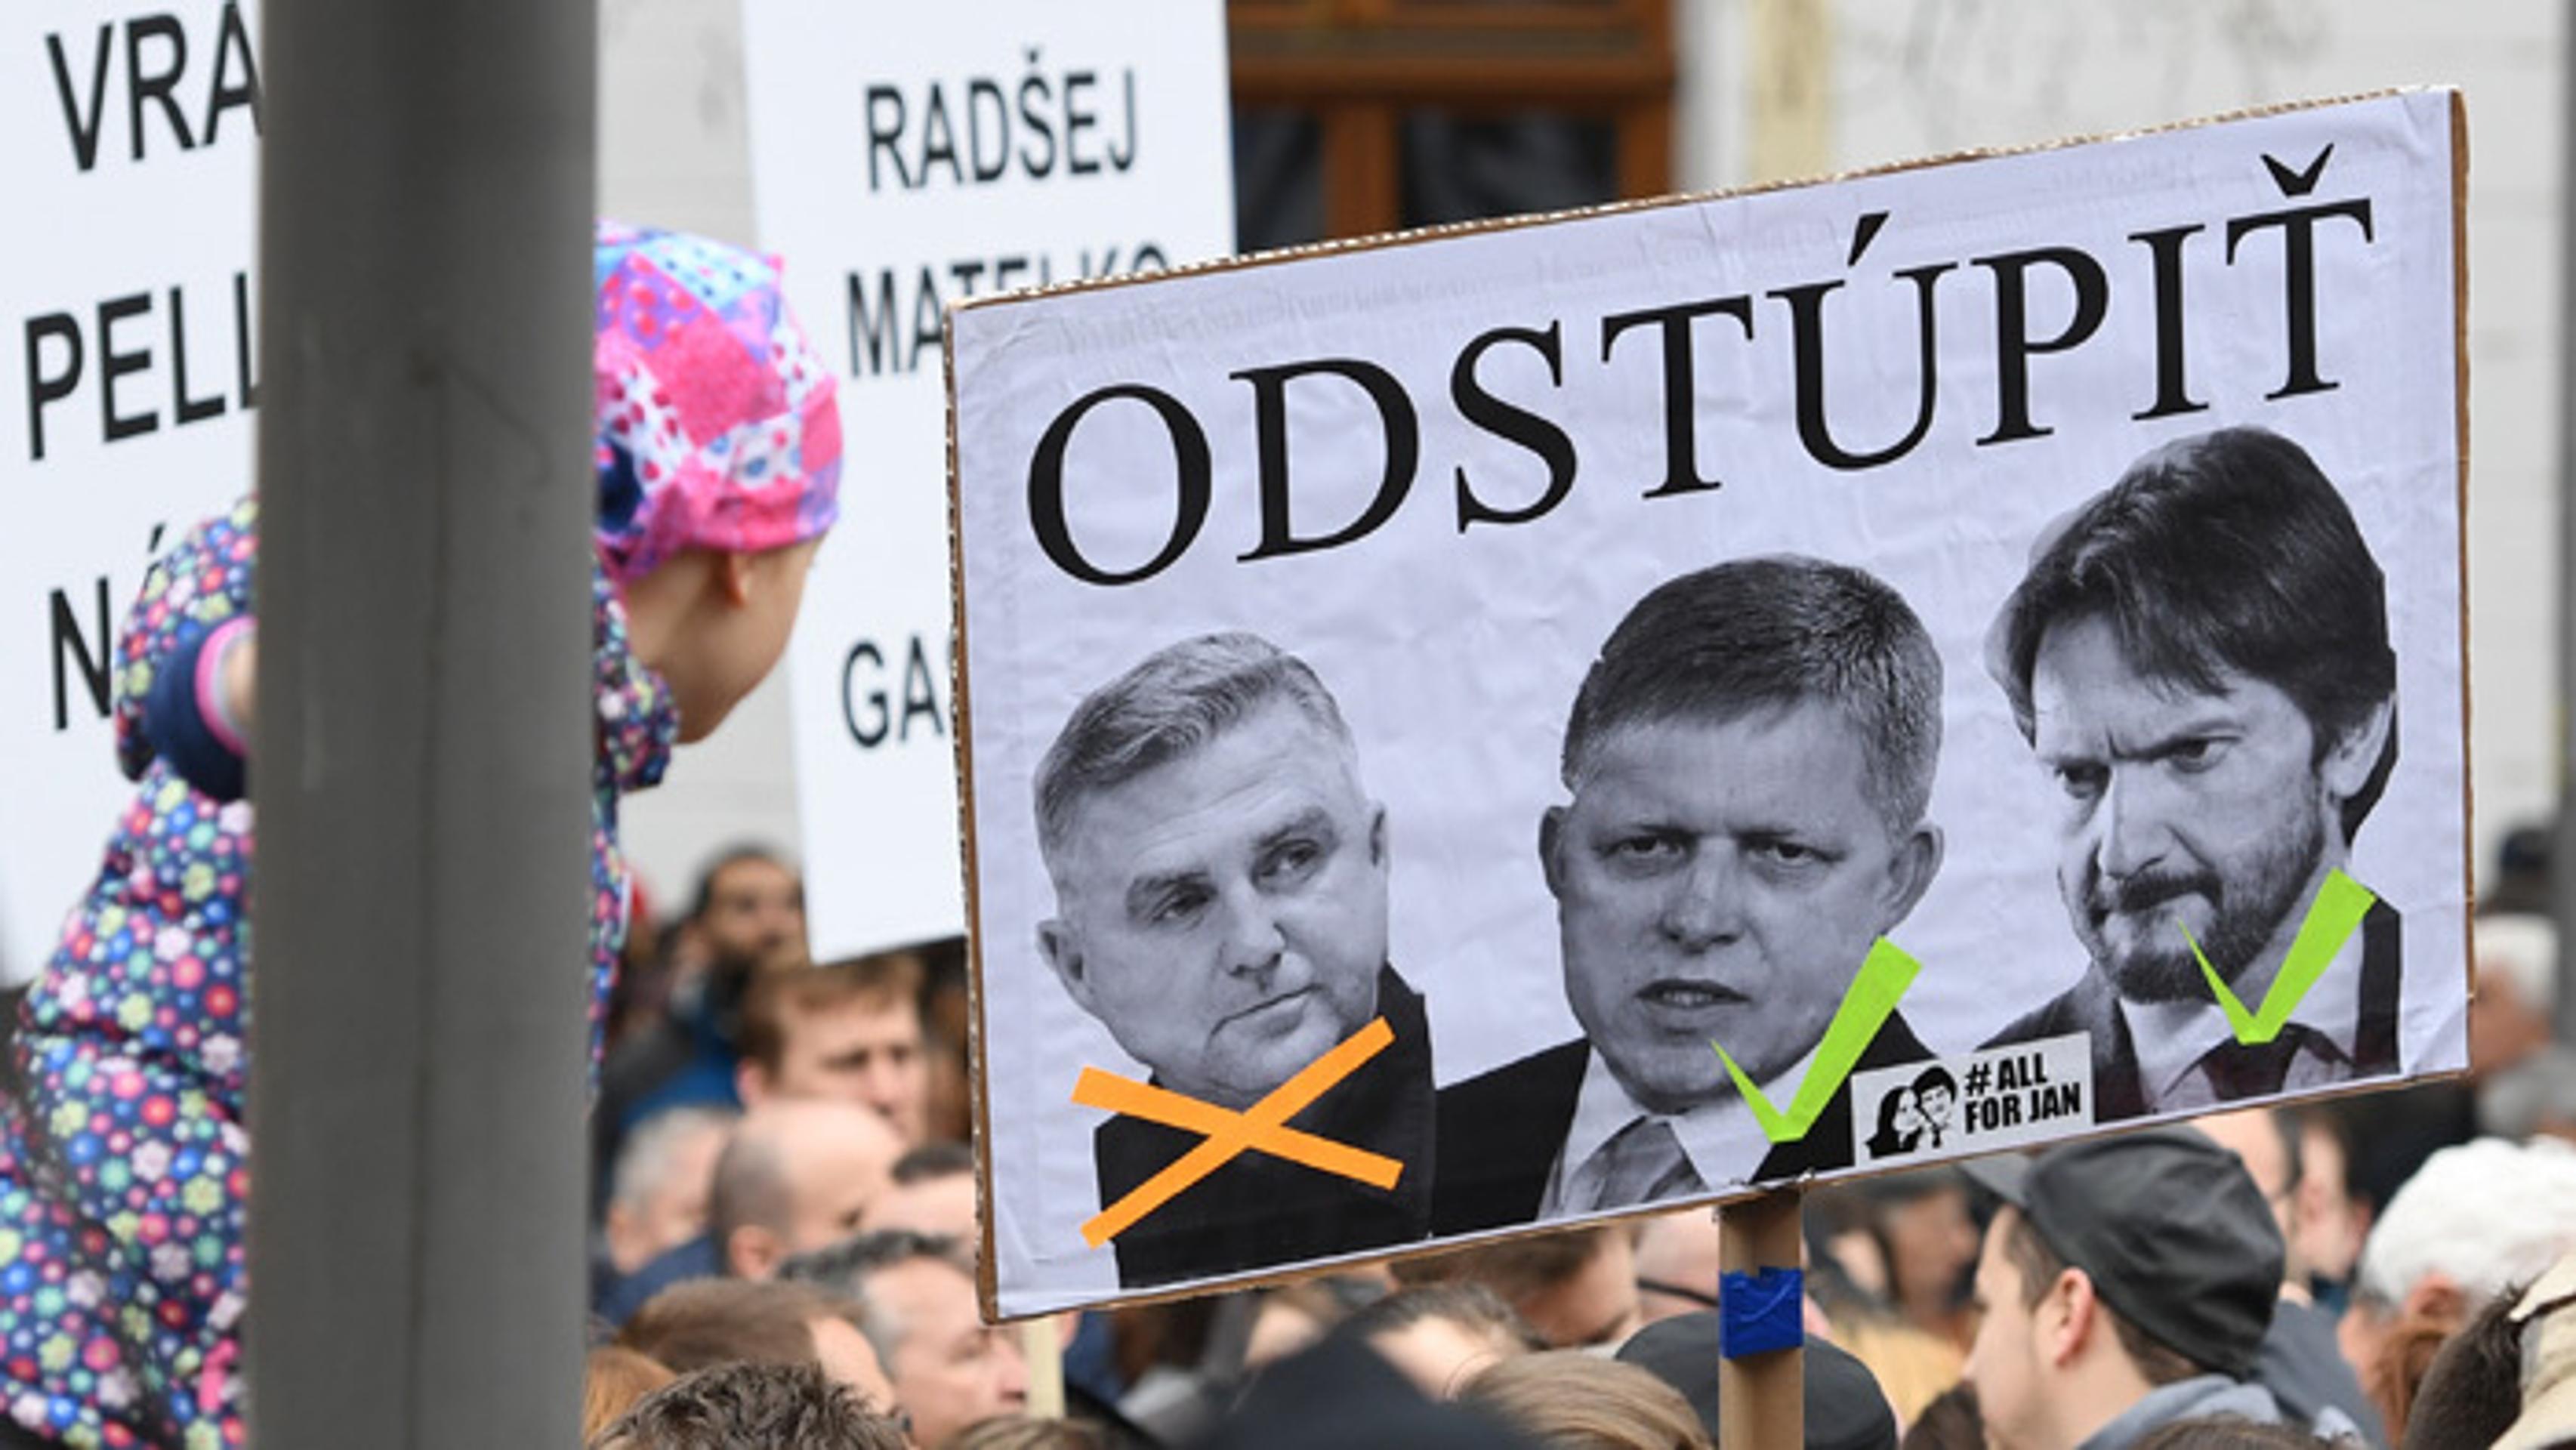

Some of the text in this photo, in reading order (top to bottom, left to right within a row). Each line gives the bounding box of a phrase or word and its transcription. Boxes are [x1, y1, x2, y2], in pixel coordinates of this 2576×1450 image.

[865, 47, 1137, 190] RADŠEJ
[1026, 143, 2377, 588] ODSTÚPIŤ
[1966, 1082, 2081, 1134] FOR JAN
